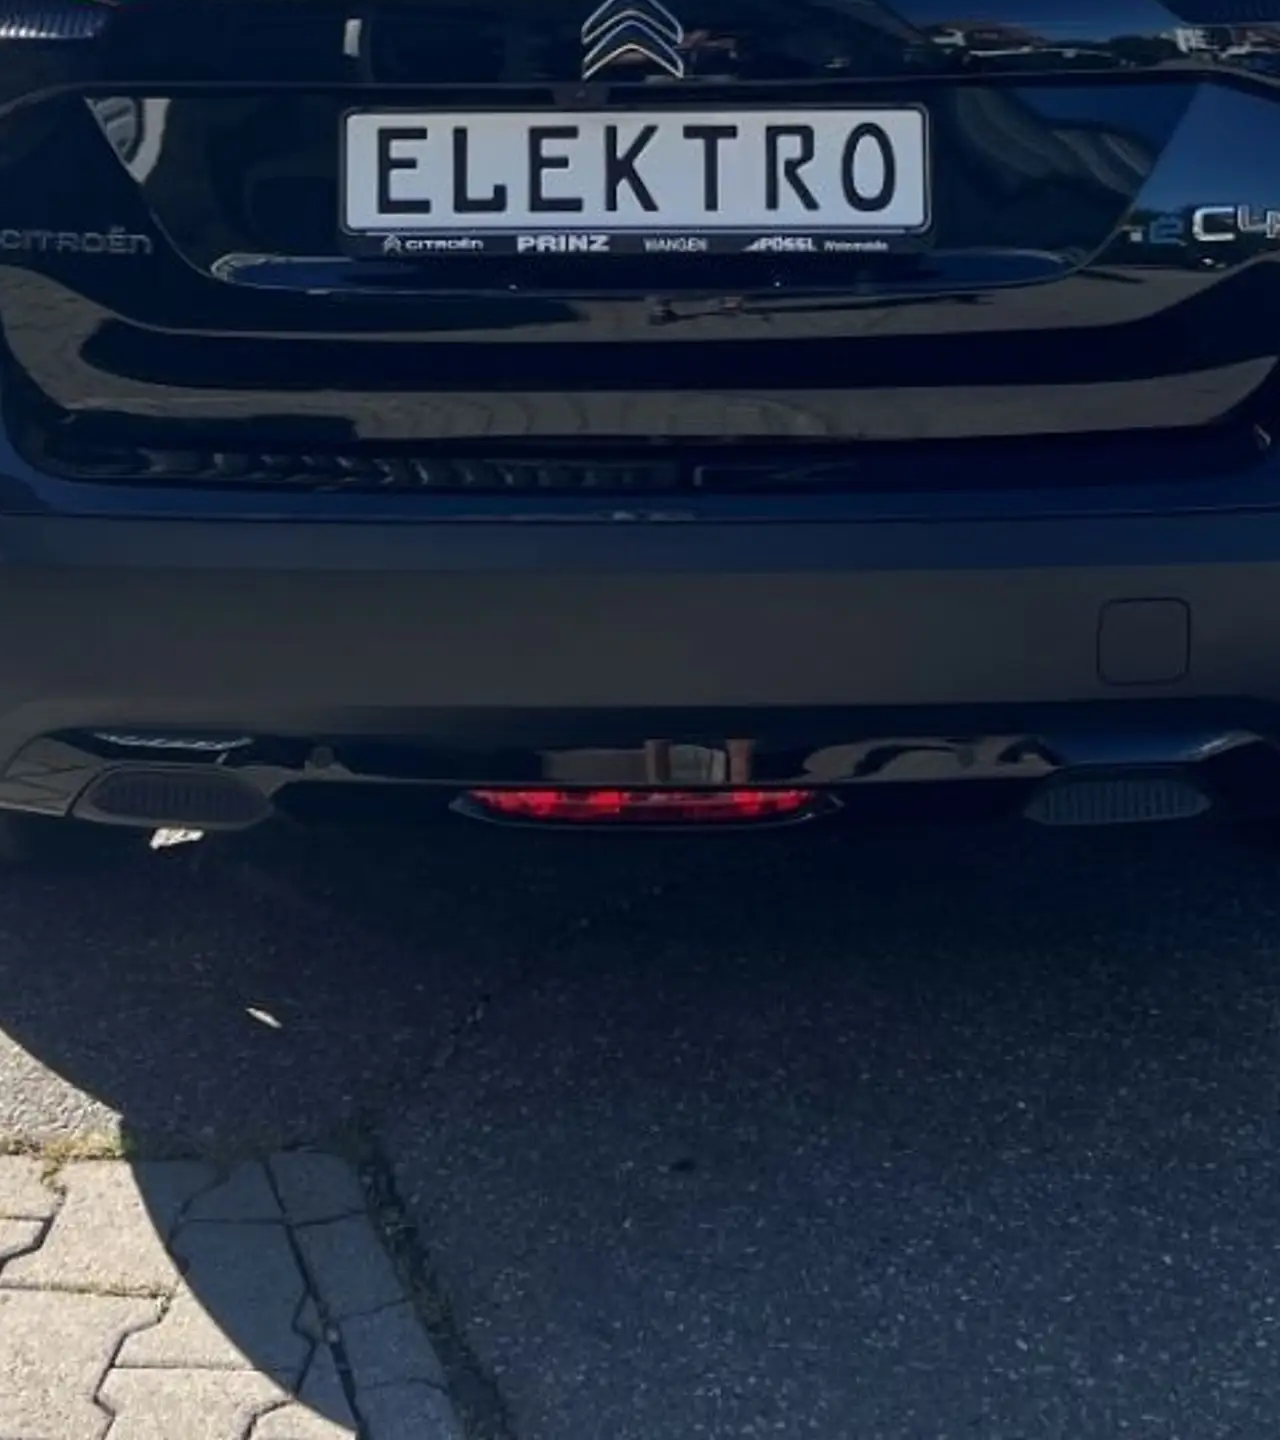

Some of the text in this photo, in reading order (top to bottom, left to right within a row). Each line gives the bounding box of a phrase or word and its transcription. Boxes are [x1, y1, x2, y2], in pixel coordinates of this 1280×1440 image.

[376, 122, 896, 214] ELEKTRO
[405, 237, 484, 251] CITROËN
[517, 234, 611, 253] PRINZ
[643, 237, 708, 253] WANGEN
[758, 236, 817, 252] PÖSSL
